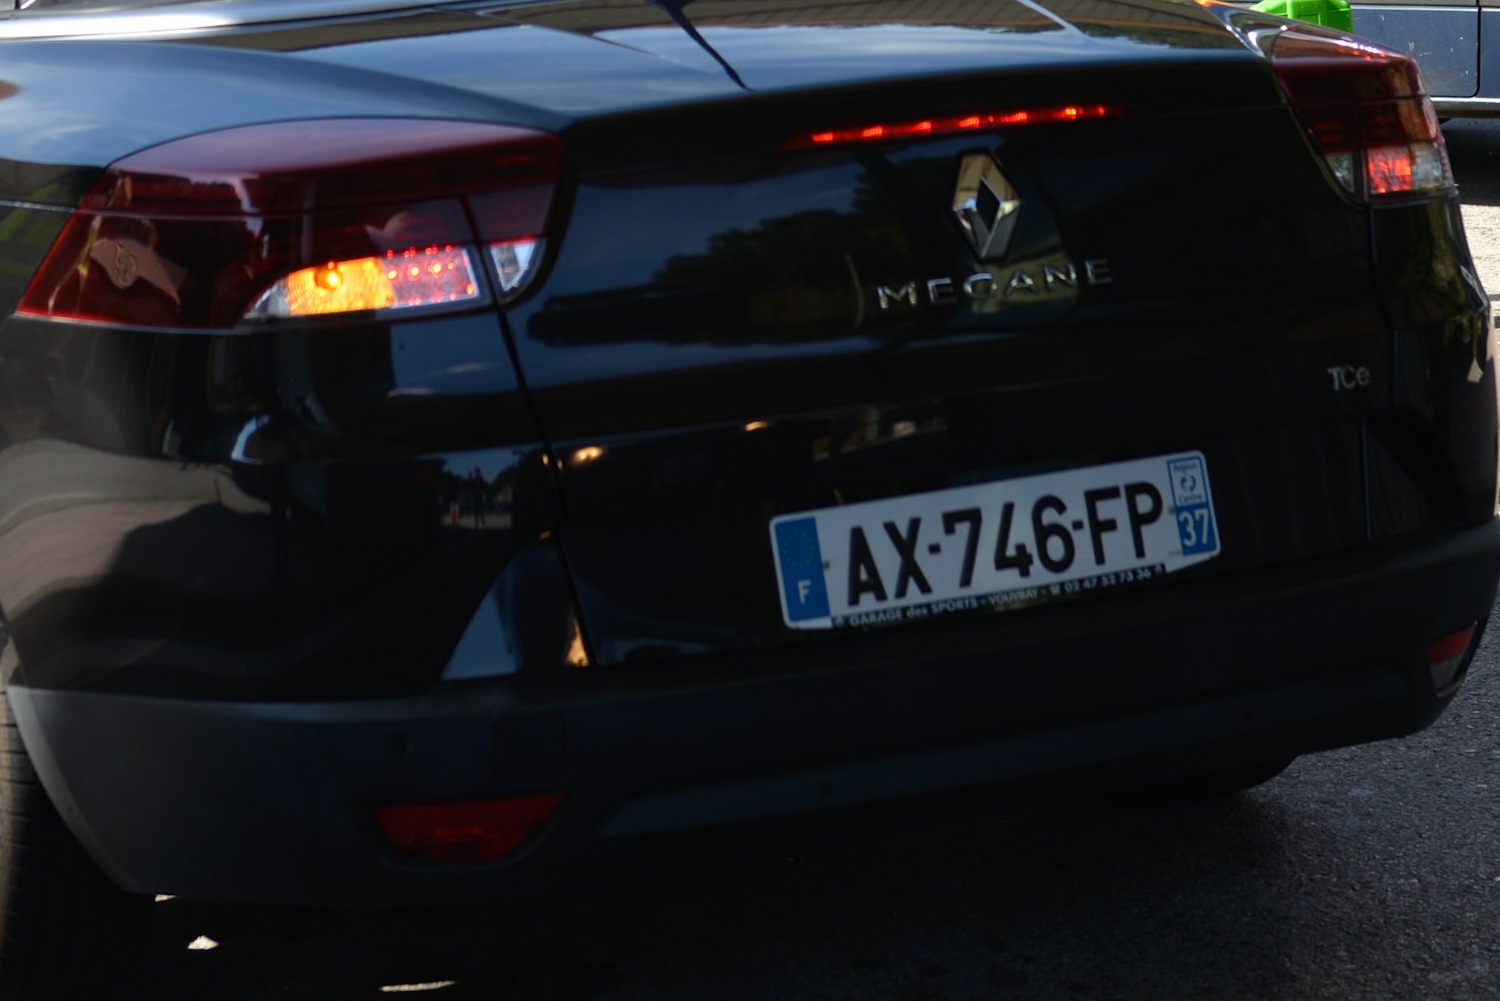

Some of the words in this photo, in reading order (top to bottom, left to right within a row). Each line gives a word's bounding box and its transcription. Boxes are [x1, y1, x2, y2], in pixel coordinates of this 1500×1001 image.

[876, 258, 1114, 310] MEGANE
[1178, 507, 1210, 548] 37
[797, 579, 812, 605] F
[850, 610, 901, 627] GARAGE
[906, 605, 928, 618] des
[931, 596, 978, 615] SPORTS
